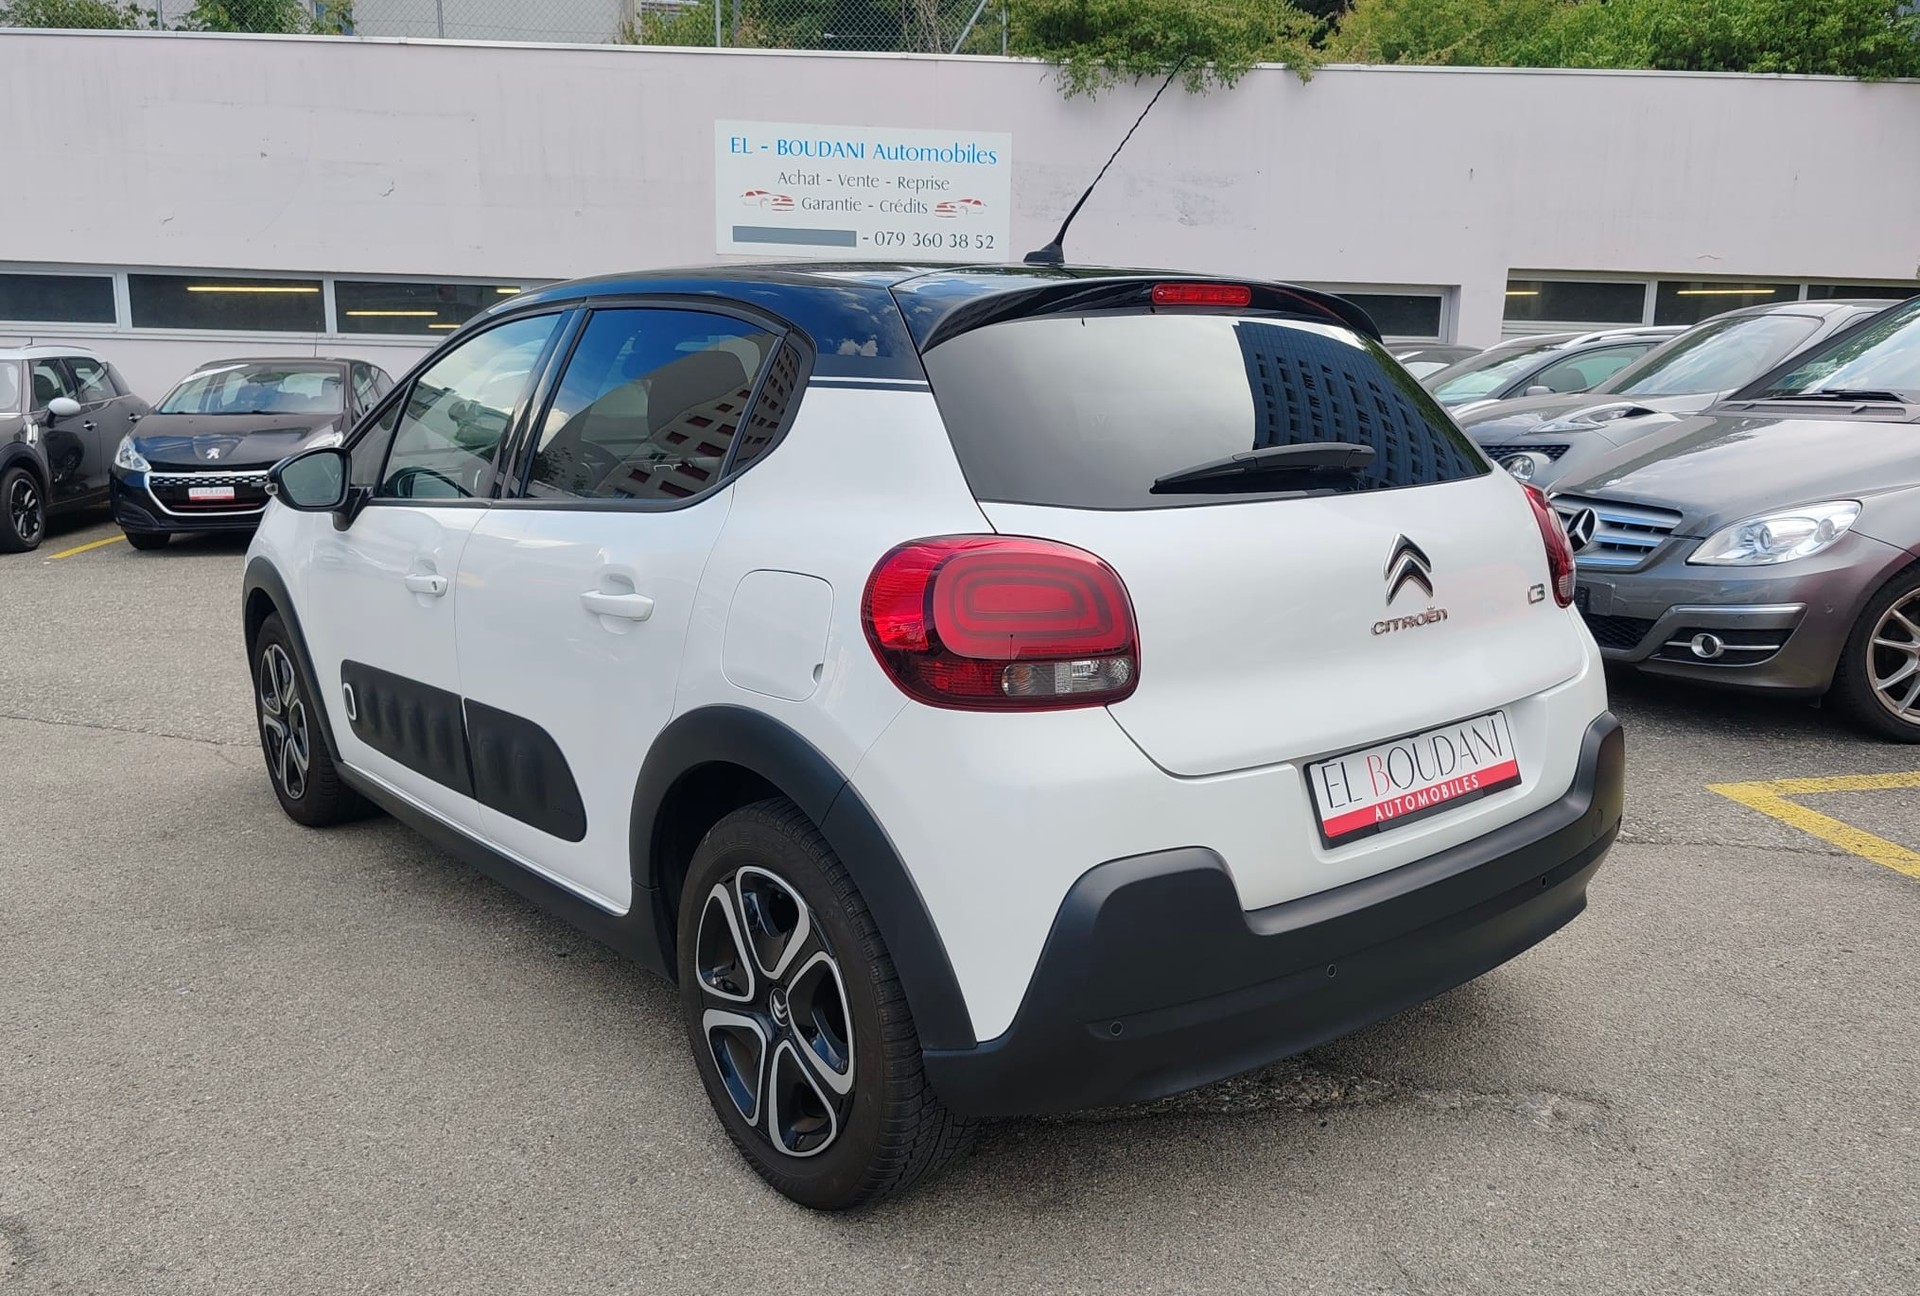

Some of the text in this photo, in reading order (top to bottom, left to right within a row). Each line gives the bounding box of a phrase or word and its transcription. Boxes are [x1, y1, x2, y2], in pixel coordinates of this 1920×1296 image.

[730, 136, 753, 154] EL
[777, 139, 865, 159] BOUDANI
[872, 142, 998, 165] Automobiles
[777, 169, 821, 186] Achat
[838, 173, 880, 188] Vente
[897, 175, 950, 194] Reprise
[801, 197, 862, 212] Garantie
[879, 198, 929, 215] Crédits
[874, 231, 906, 247] 079
[911, 232, 943, 248] 360
[948, 233, 969, 249] 38
[975, 234, 995, 250] 52
[1527, 583, 1546, 605] C3
[1321, 719, 1503, 809] EL BOUDANI
[1375, 774, 1480, 822] AUTOMOBILES
